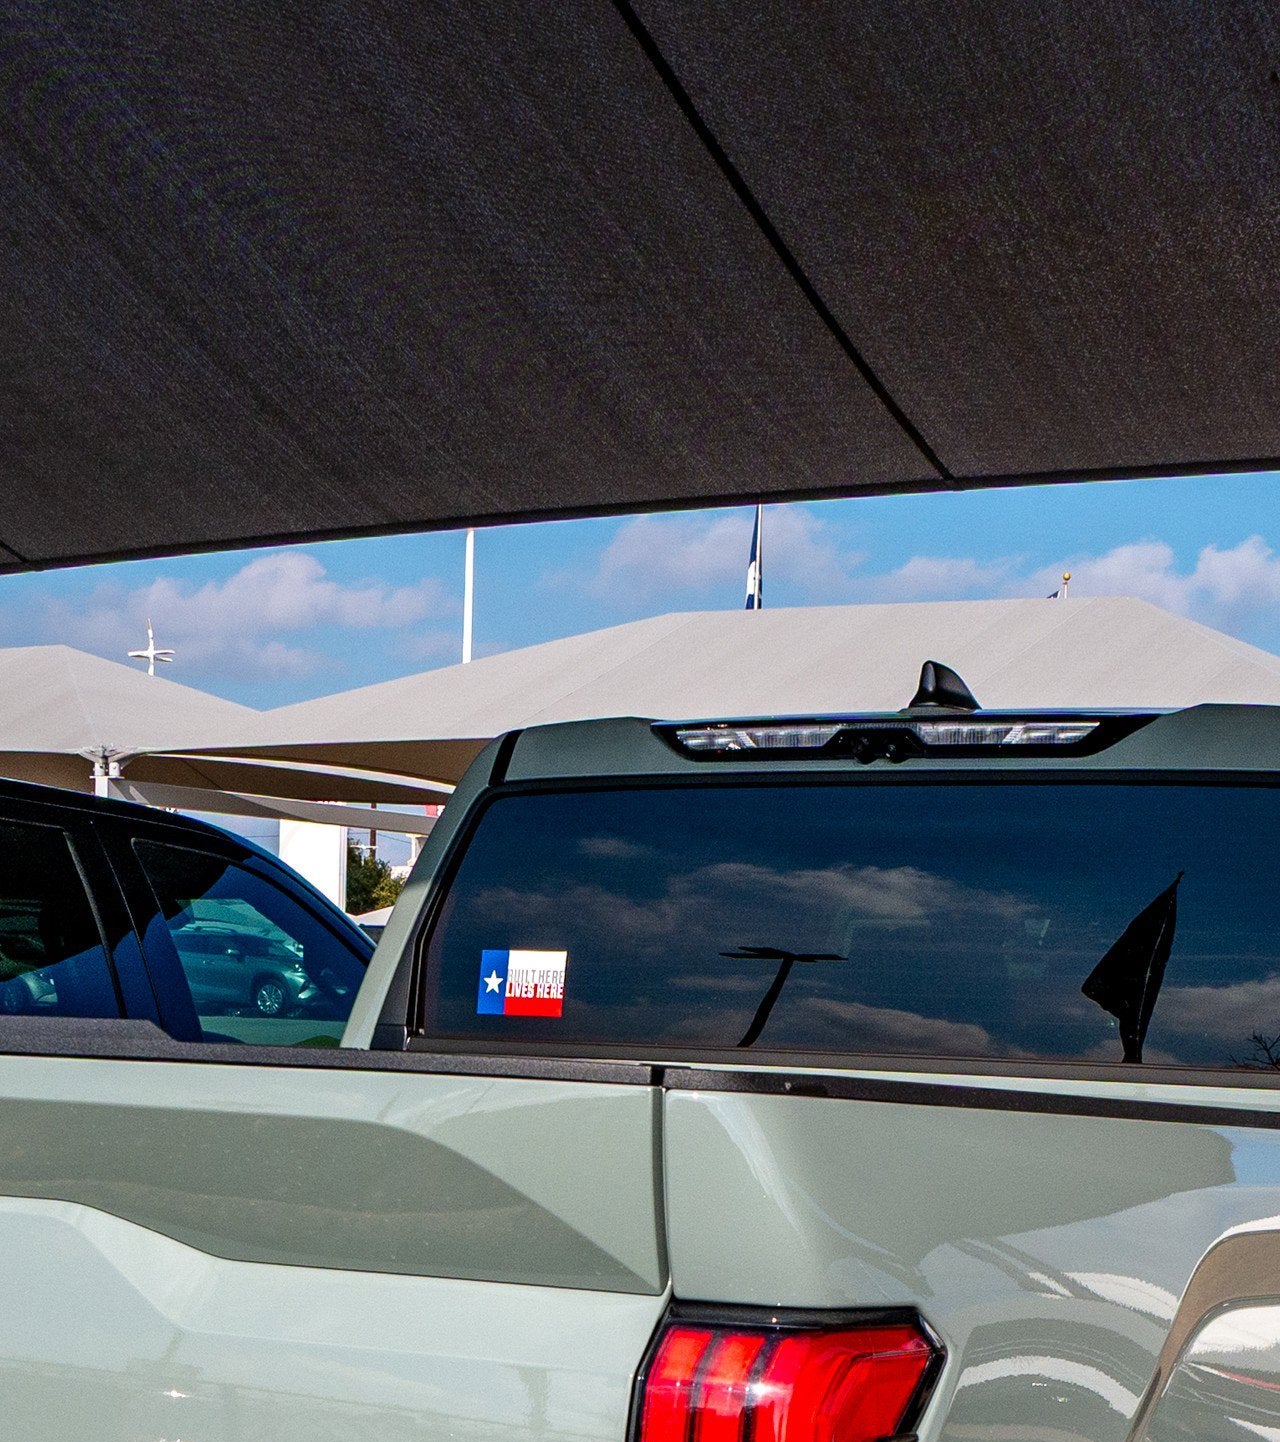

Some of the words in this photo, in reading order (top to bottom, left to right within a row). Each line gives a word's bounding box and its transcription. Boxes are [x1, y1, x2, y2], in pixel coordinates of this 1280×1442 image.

[508, 968, 536, 984] BUILT
[538, 969, 566, 985] HERE
[505, 982, 535, 998] LIVES
[536, 983, 564, 999] HERE
